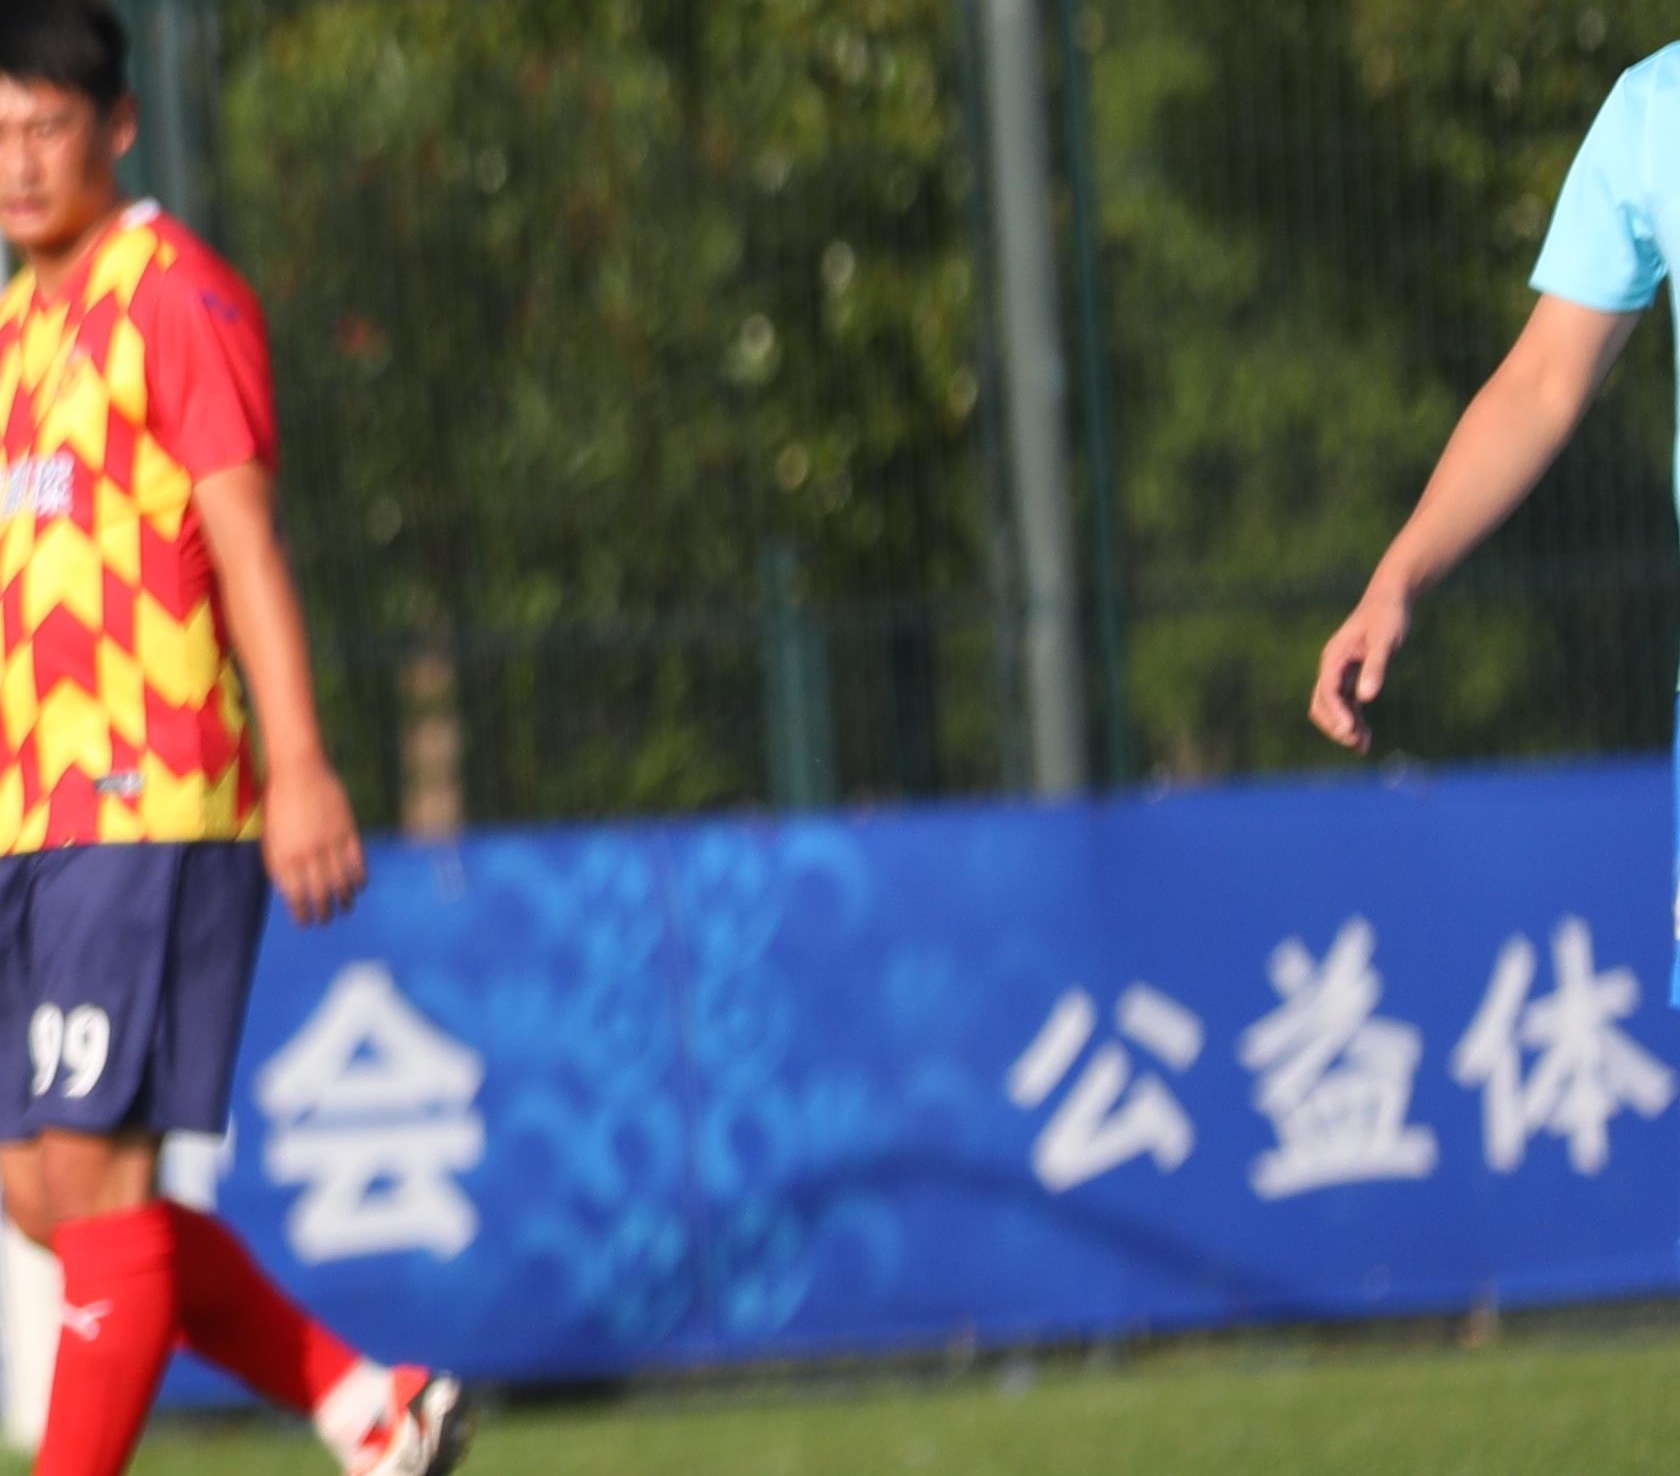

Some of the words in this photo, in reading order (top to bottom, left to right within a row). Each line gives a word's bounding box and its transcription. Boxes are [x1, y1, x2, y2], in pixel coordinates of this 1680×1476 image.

[29, 1002, 110, 1098] 99
[1006, 915, 1674, 1200] 公益体
